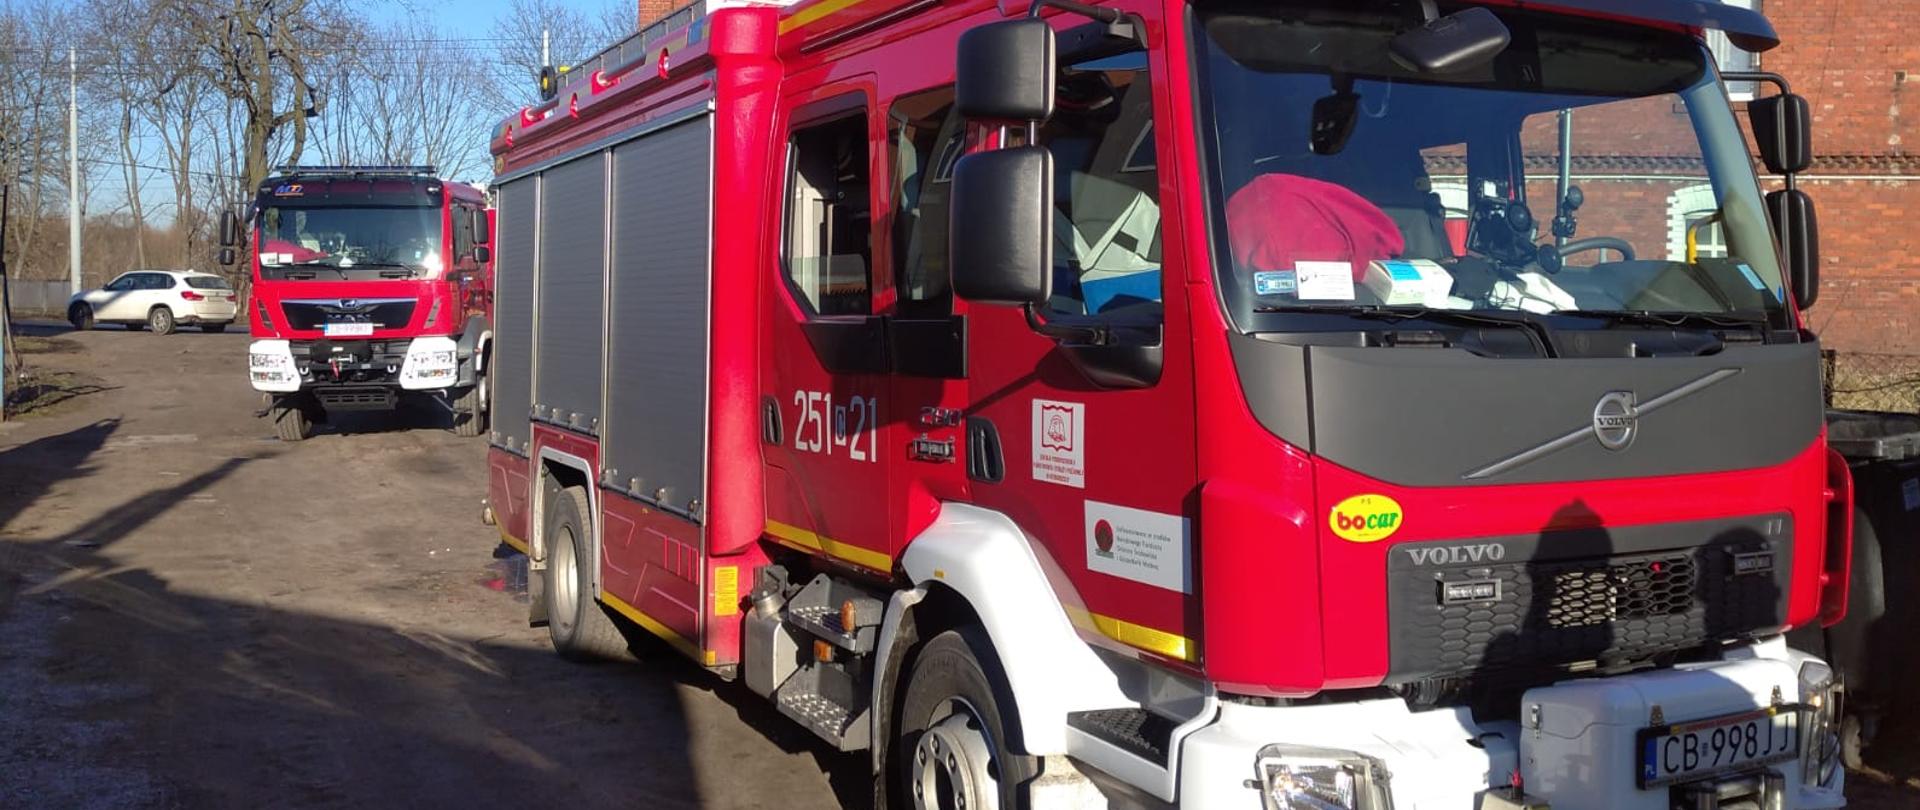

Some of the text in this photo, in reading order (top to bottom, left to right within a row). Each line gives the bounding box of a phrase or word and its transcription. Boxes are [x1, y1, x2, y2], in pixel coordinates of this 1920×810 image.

[794, 390, 832, 455] 251
[849, 395, 877, 462] 21
[1597, 417, 1633, 426] VOLVO
[1337, 511, 1399, 531] bocar
[1406, 543, 1506, 566] VOLVO
[1664, 715, 1789, 773] CB 998JJ
